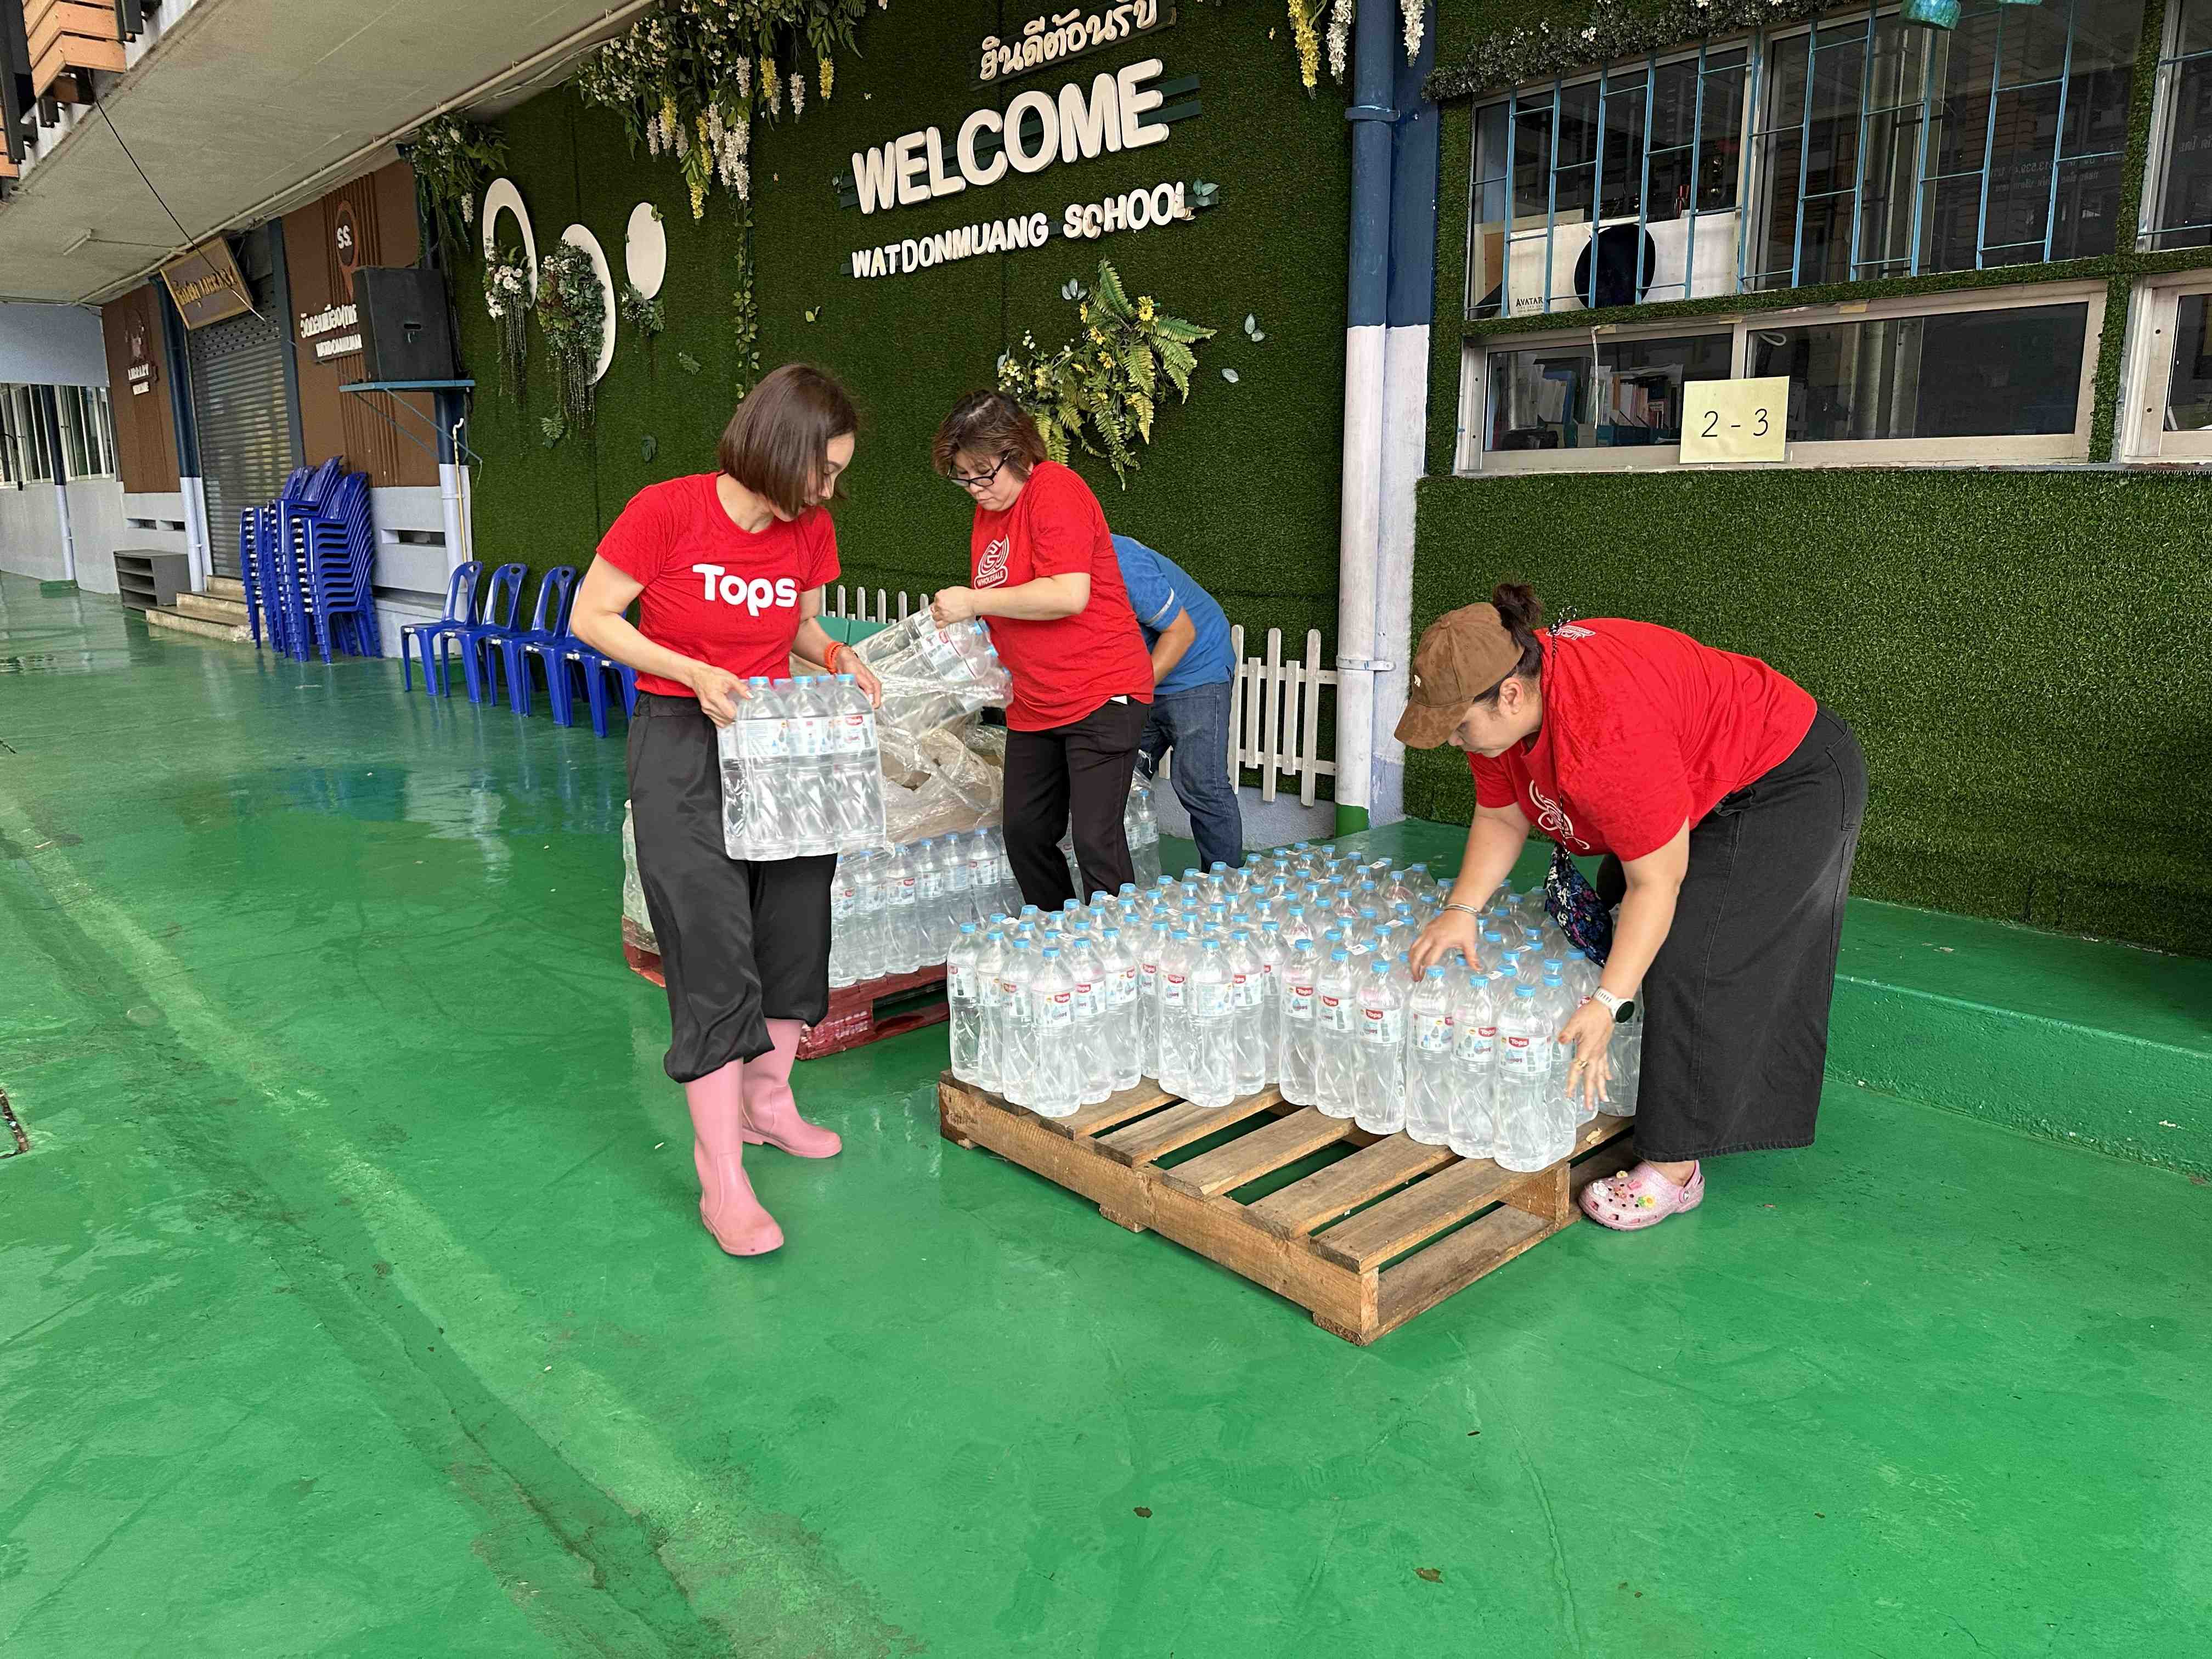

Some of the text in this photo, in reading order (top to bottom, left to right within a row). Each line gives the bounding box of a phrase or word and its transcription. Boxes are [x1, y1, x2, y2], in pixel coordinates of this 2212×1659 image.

[851, 58, 1170, 215] WELCOME
[851, 180, 1187, 279] WATDONMUANG SCHOOL
[1516, 296, 1544, 307] AVATAR
[1701, 410, 1719, 437] 2
[1752, 408, 1769, 437] 3
[977, 570, 1004, 588] WHOLESALE
[692, 563, 798, 617] Tops
[1057, 995, 1070, 1003] Tops
[1367, 1011, 1382, 1019] Tops
[1510, 1038, 1528, 1047] Tops
